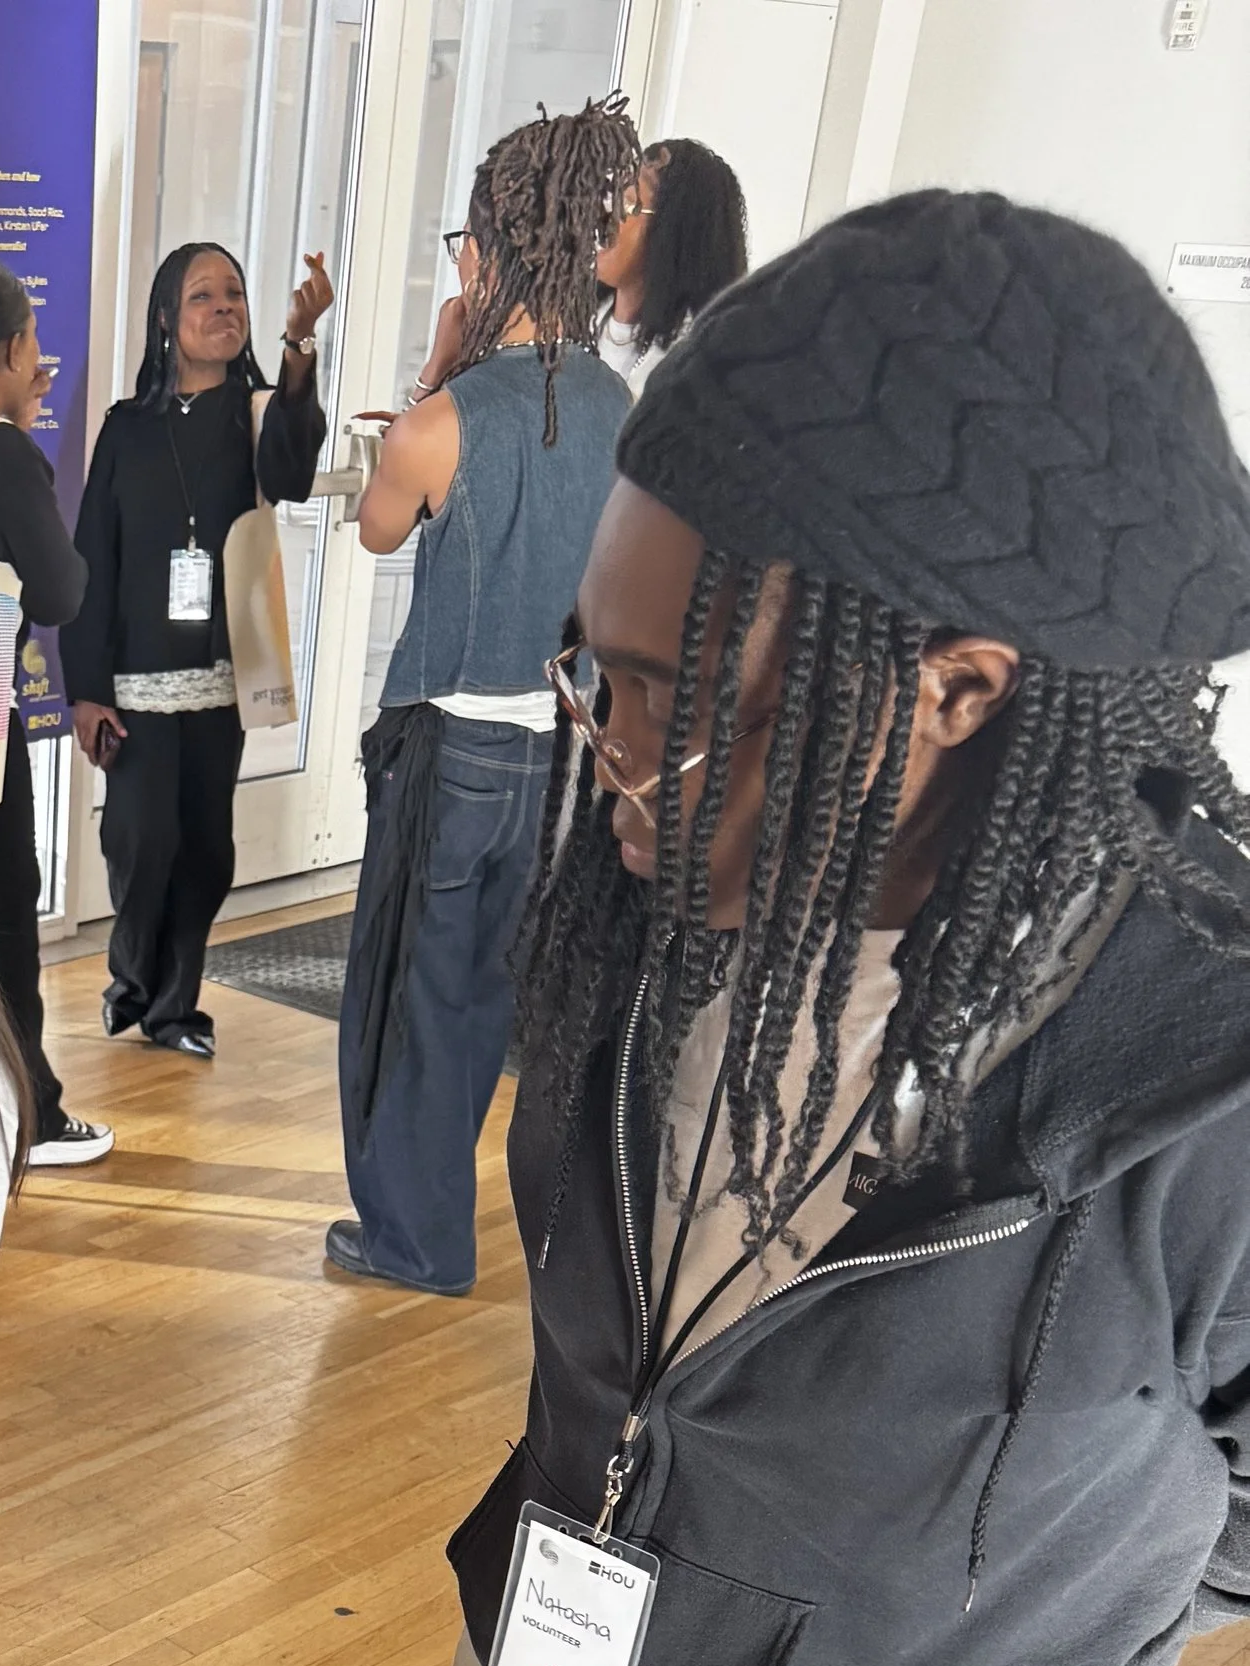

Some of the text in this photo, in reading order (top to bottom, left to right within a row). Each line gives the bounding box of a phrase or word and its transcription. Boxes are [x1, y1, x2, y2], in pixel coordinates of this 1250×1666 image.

[600, 1565, 636, 1589] HOU
[526, 1578, 612, 1642] Natasha
[522, 1614, 581, 1649] VOLUNTEER
